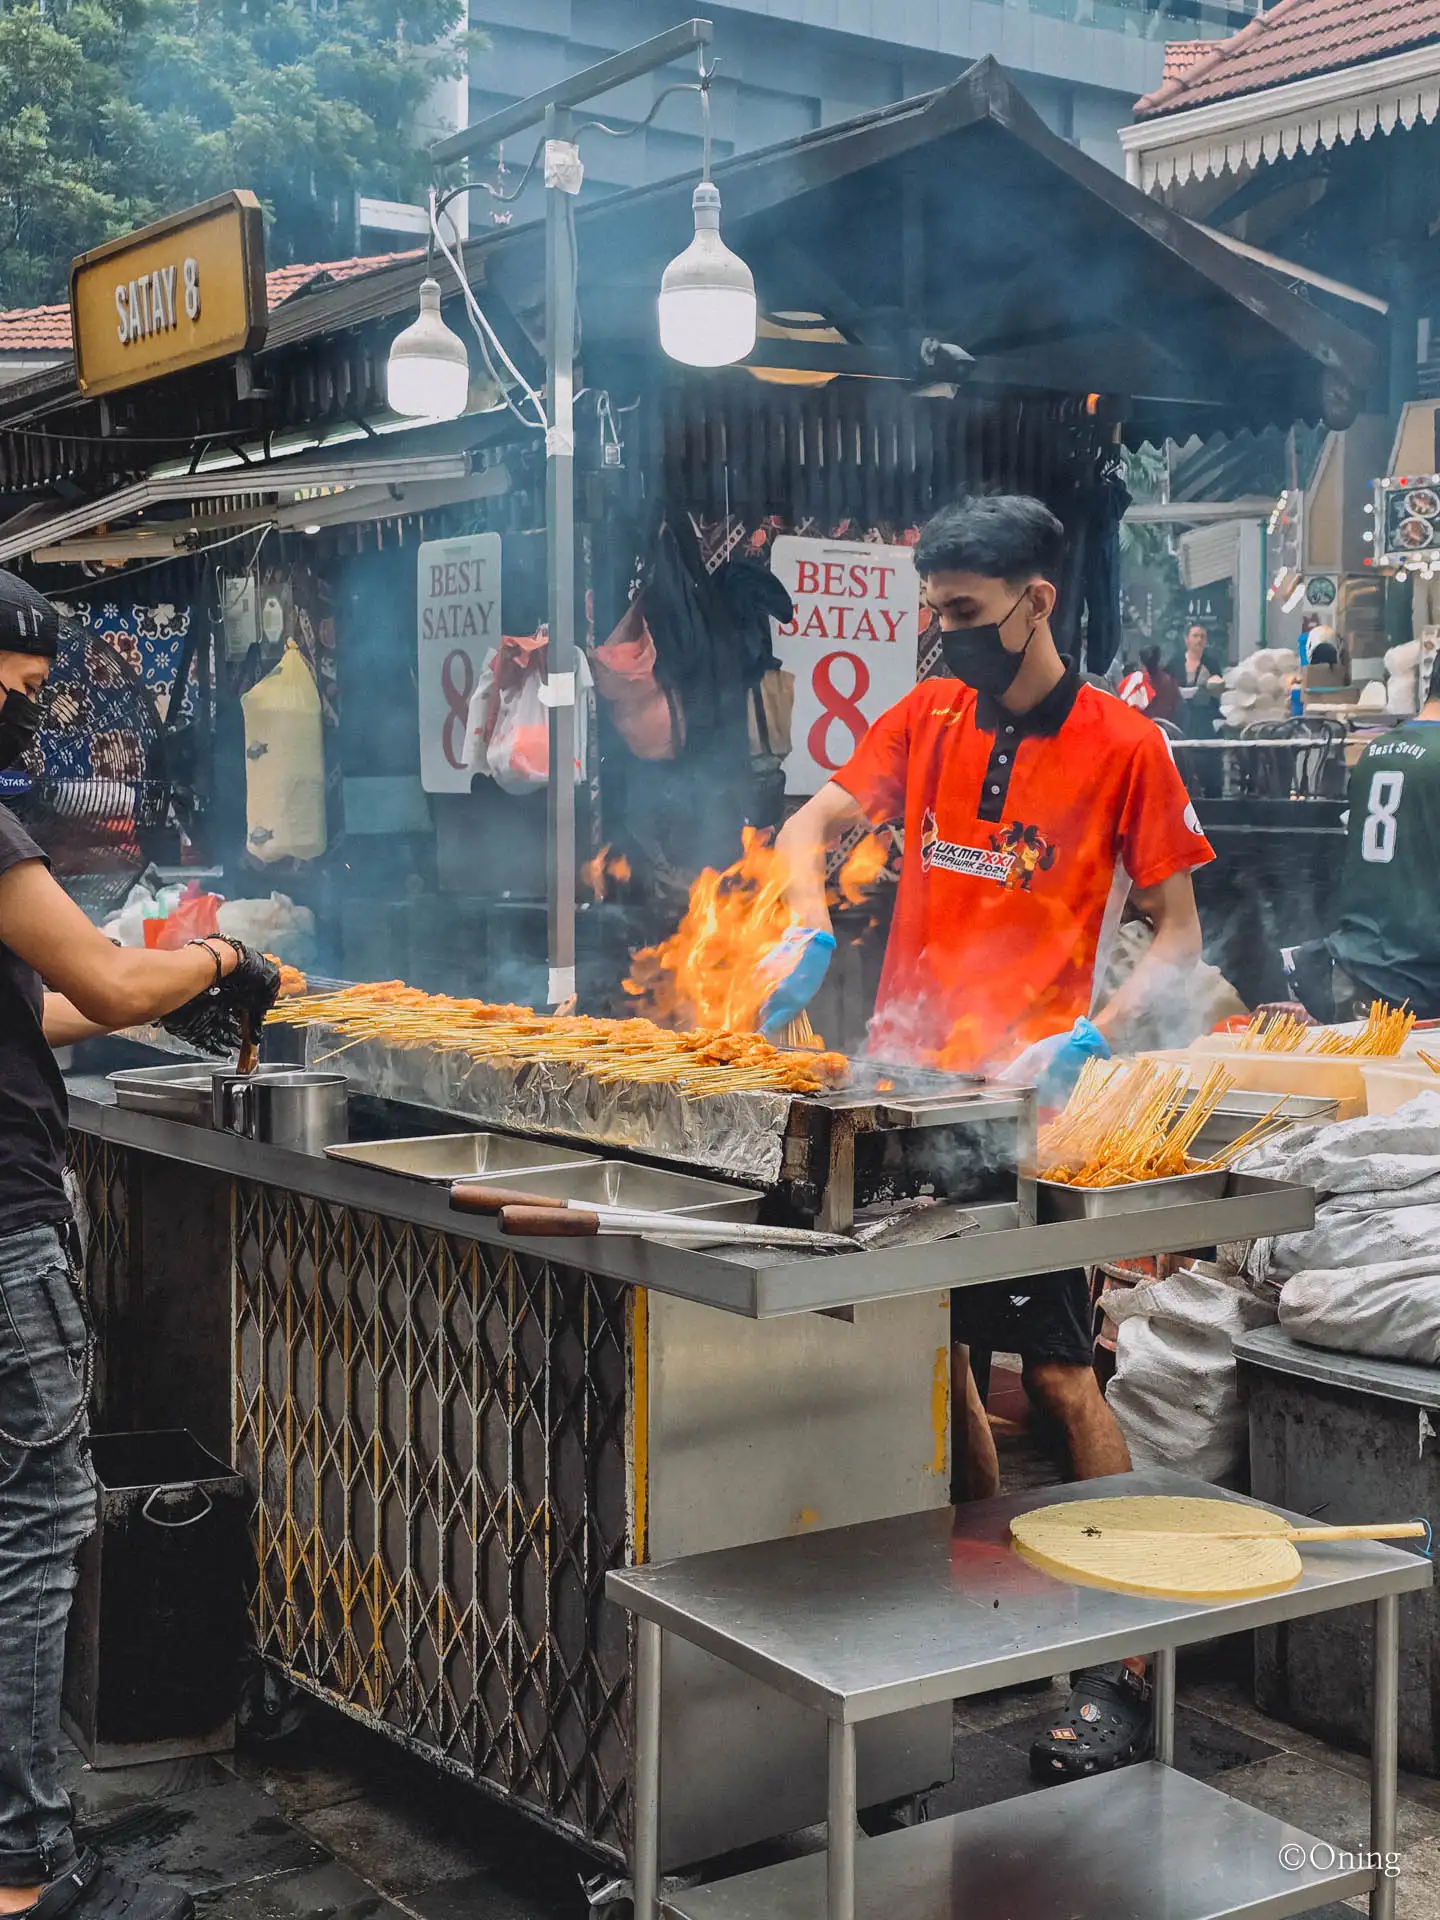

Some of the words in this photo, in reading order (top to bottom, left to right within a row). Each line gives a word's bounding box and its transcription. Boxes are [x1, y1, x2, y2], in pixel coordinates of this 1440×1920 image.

[115, 265, 177, 344] SATAY
[184, 257, 200, 320] 8
[429, 558, 487, 598] BEST
[794, 560, 896, 600] BEST
[422, 601, 495, 640] SATAY
[778, 604, 908, 643] SATAY
[441, 649, 474, 770] 8
[807, 651, 870, 770] 8
[1362, 771, 1405, 863] 8
[976, 863, 1008, 876] 2024
